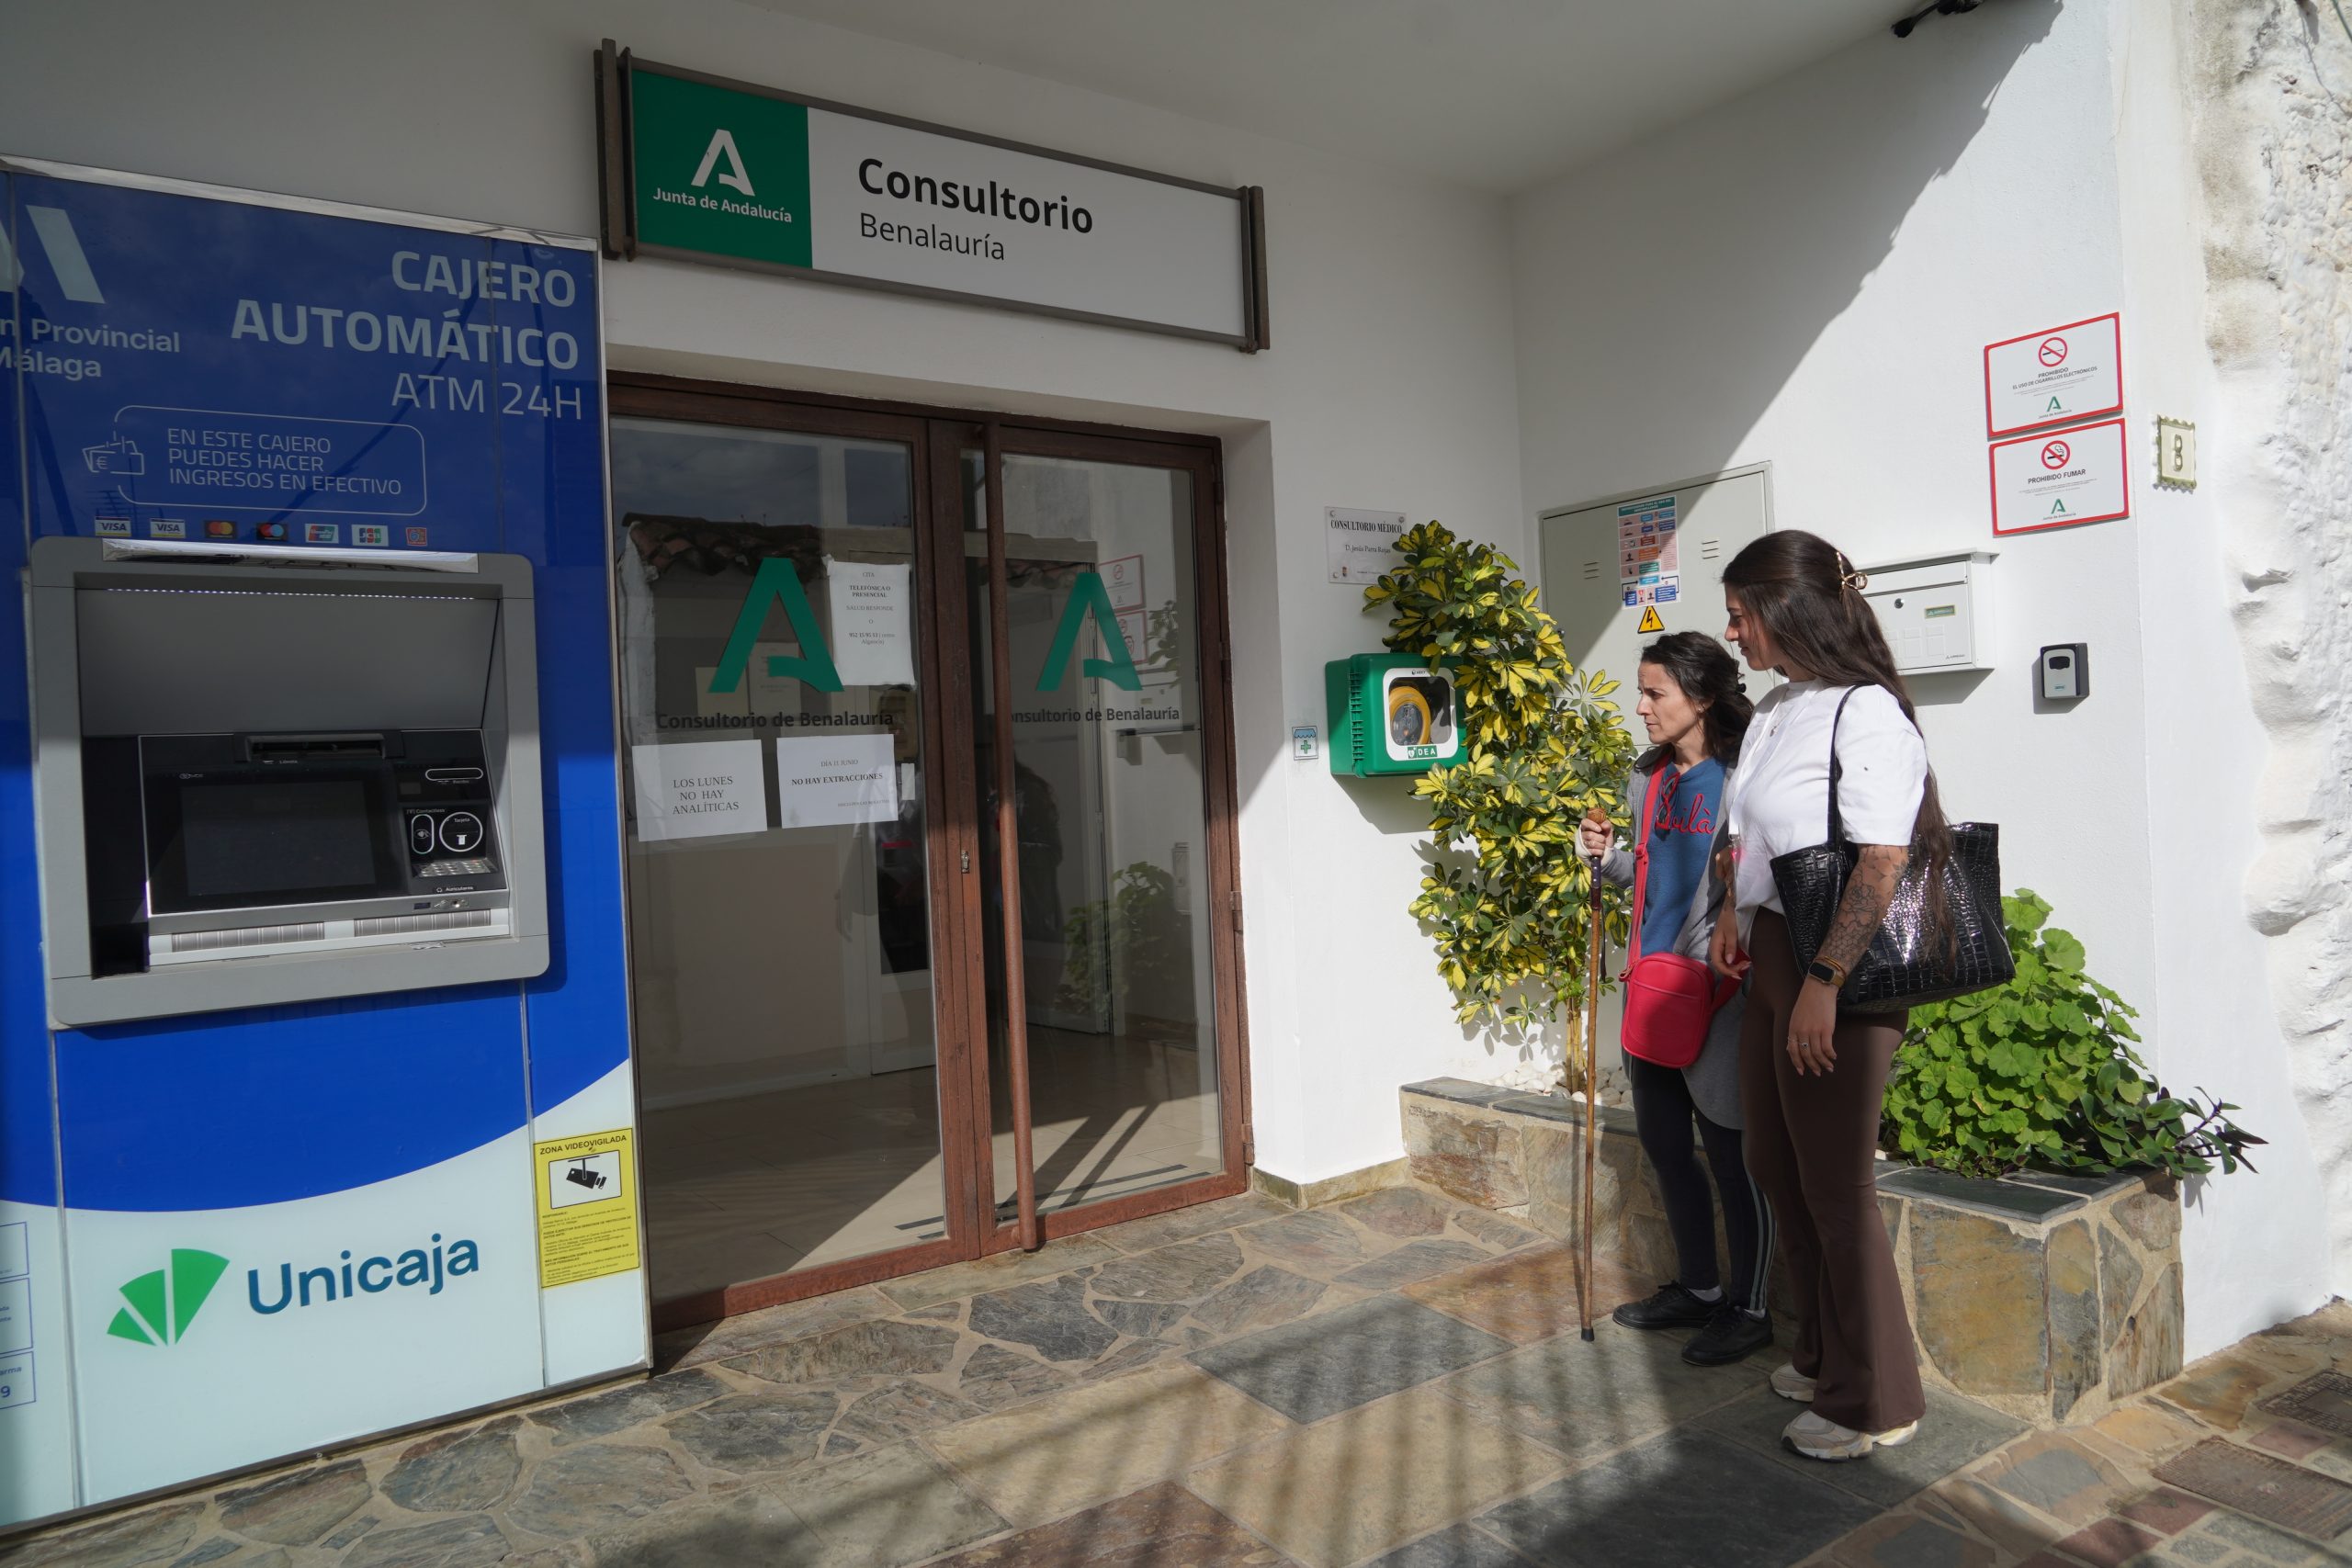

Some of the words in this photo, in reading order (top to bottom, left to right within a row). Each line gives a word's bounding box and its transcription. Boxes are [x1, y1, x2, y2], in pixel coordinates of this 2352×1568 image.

[653, 188, 696, 206] Junta
[700, 196, 718, 209] de
[721, 199, 792, 222] Andalucía
[858, 158, 1093, 234] Consultorio
[860, 211, 1005, 261] Benalauría
[391, 251, 575, 307] CAJERO
[31, 318, 180, 353] Provincial
[231, 299, 579, 369] AUTOMÁTICO
[2035, 375, 2063, 385] CIGARRILLOS
[2038, 367, 2068, 378] PROHIBIDO
[391, 373, 484, 413] ATM
[502, 382, 581, 420] 24H
[168, 428, 195, 445] EN
[203, 431, 253, 448] ESTE
[259, 434, 331, 453] CAJERO
[169, 448, 252, 468] PUEDES
[258, 454, 323, 471] HACER
[170, 468, 274, 488] INGRESOS
[280, 475, 306, 490] EN
[313, 476, 401, 494] EFECTIVO
[2028, 473, 2062, 484] PROHIBIDO
[2064, 469, 2086, 478] FUMAR
[101, 523, 126, 531] VISA
[156, 523, 180, 532] VISA
[1331, 520, 1375, 532] CONSULTORIO
[1377, 522, 1402, 533] MÉDICO
[657, 712, 767, 729] Consultorio
[772, 712, 794, 727] de
[801, 711, 893, 727] Benalauría
[1012, 708, 1080, 722] nsultorio
[1085, 708, 1102, 721] de
[1107, 707, 1180, 720] Benalauría
[673, 779, 695, 788] LOS
[698, 776, 733, 786] LUNES
[823, 773, 883, 784] EXTRACCIONES
[680, 792, 696, 801] NO
[702, 790, 724, 799] HAY
[673, 802, 740, 815] ANALÍTICAS
[540, 1145, 562, 1155] ZONA
[565, 1134, 627, 1150] VIDEOVIGILADA
[248, 1233, 480, 1315] Unicaja
